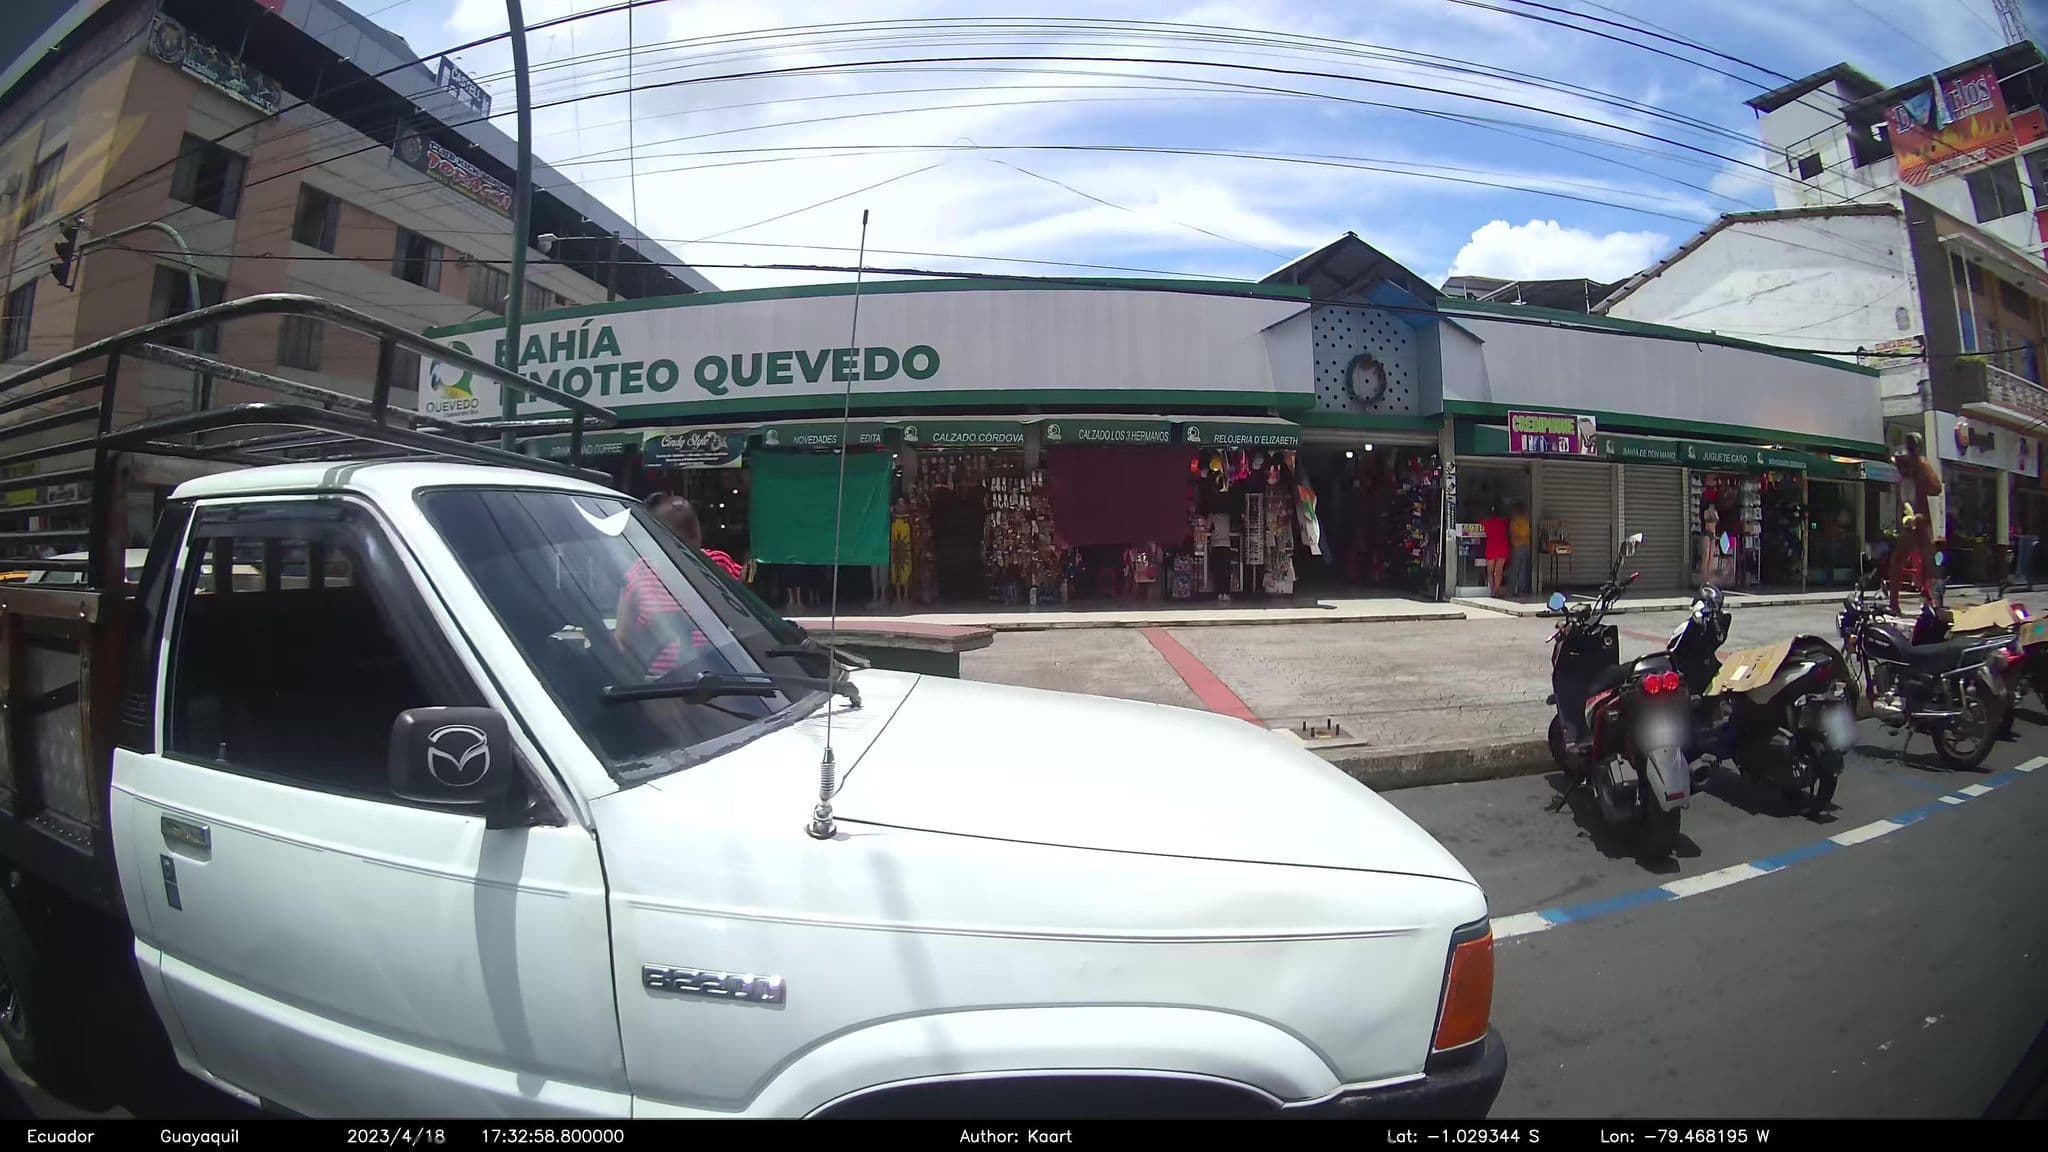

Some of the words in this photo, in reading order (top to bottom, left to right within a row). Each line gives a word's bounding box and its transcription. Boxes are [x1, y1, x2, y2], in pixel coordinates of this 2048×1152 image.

[493, 359, 679, 407] MOTEO
[694, 345, 940, 396] QUEVEDO
[793, 434, 838, 444] NOVEDADES
[860, 433, 881, 443] EDITA
[932, 432, 976, 442] CALZADO
[1078, 429, 1110, 440] CALZADO
[1111, 430, 1125, 440] LOS
[1126, 430, 1131, 440] 3
[1131, 430, 1169, 442] HERMANOS
[1213, 434, 1253, 444] RELOJERIA
